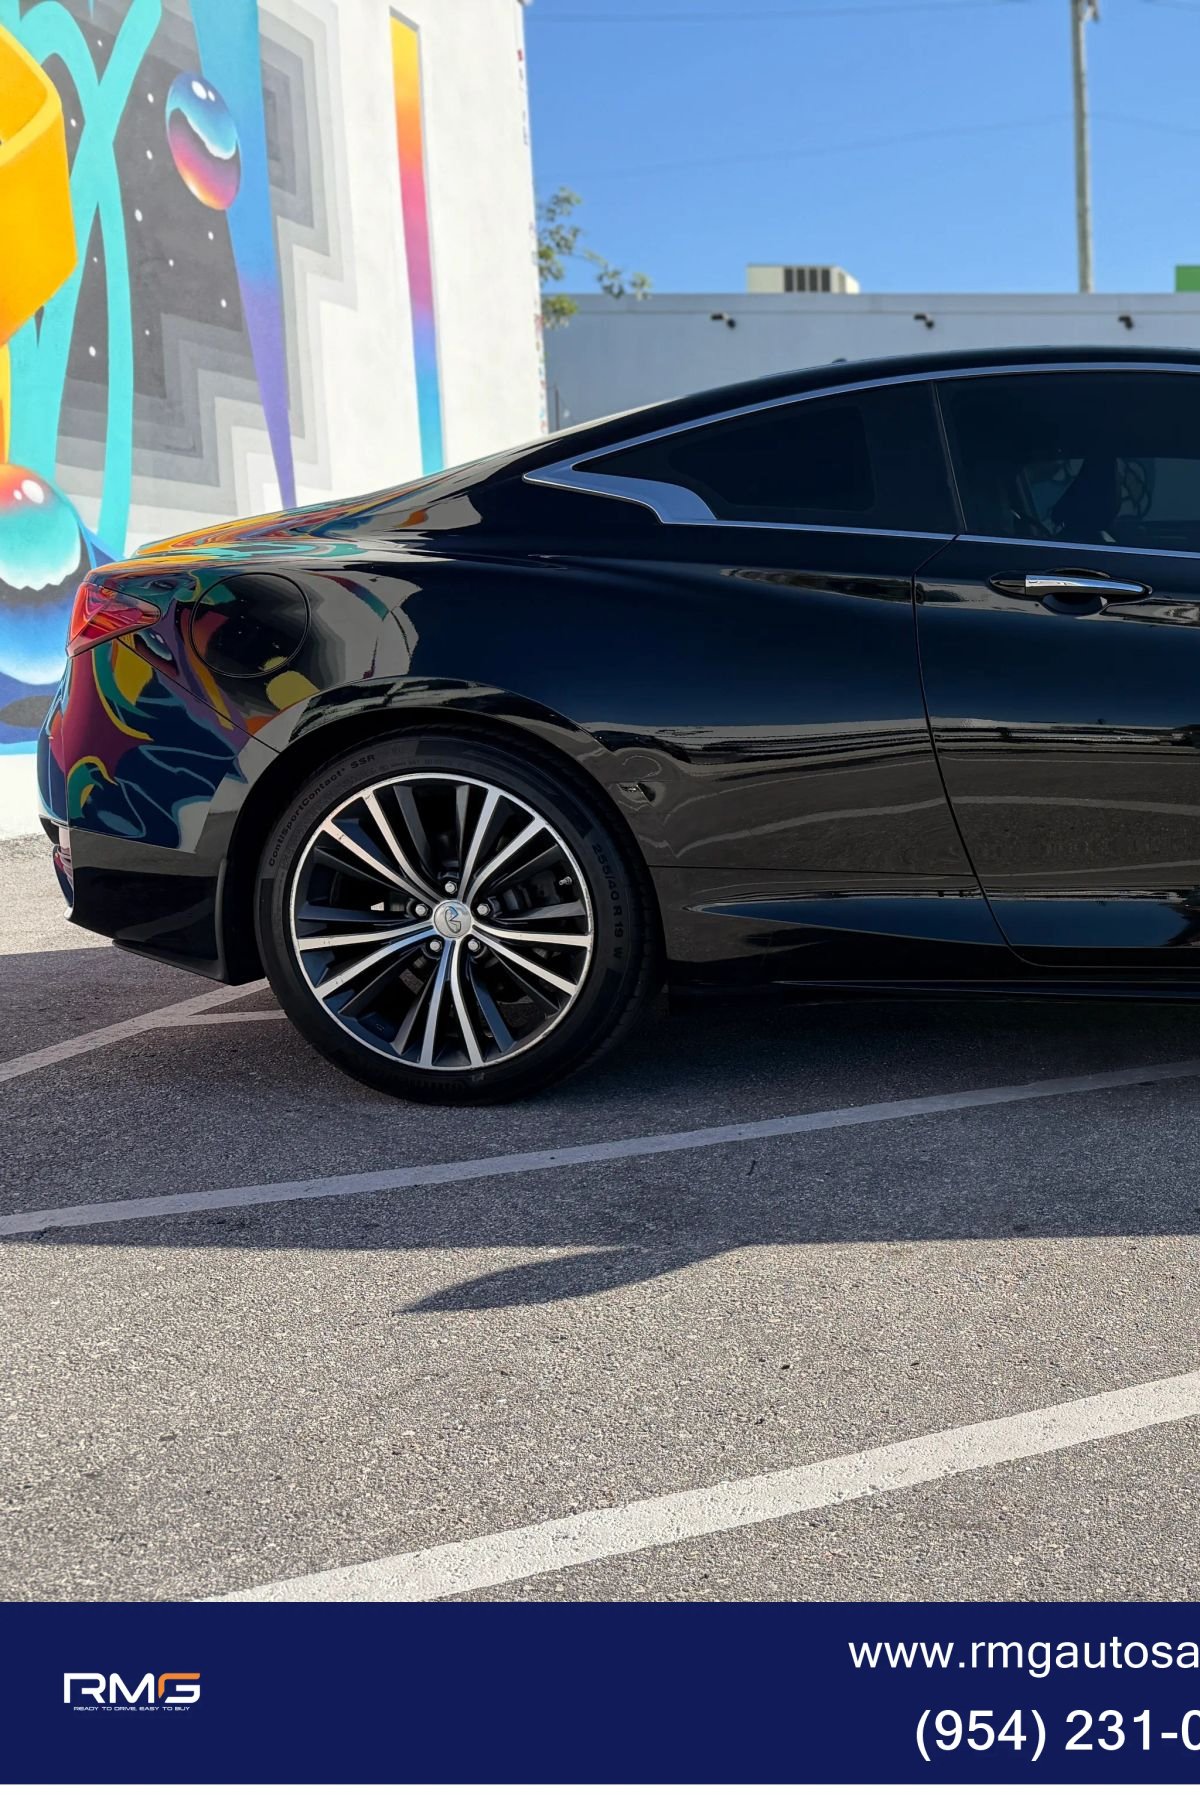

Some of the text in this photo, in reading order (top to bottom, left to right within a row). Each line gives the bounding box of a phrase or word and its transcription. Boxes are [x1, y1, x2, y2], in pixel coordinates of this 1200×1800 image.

[350, 754, 375, 769] SSR
[592, 844, 620, 901] 255/40
[614, 923, 624, 938] 19
